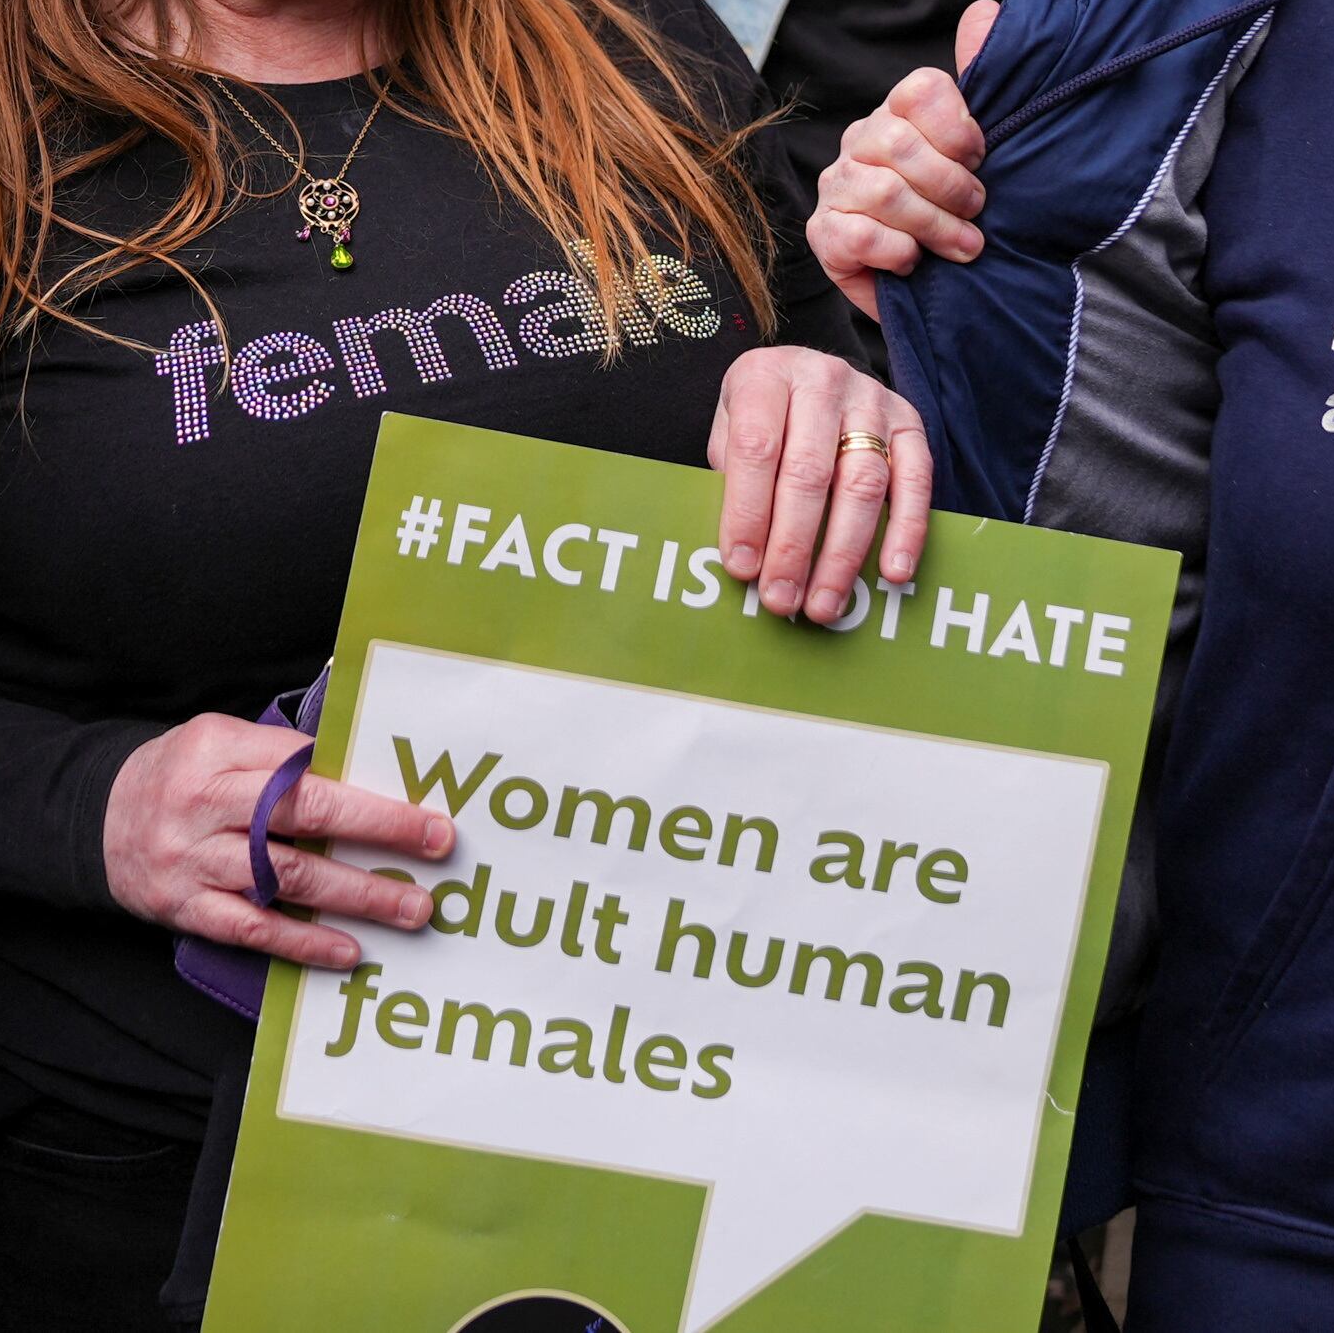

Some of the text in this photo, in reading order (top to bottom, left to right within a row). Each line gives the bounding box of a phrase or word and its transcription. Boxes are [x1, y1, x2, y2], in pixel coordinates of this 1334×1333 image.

[156, 238, 722, 445] female
[395, 494, 639, 594] #FACT
[653, 540, 722, 609] IS
[929, 585, 1132, 676] HATE
[392, 734, 970, 904] Women are
[325, 961, 737, 1099] females
[369, 862, 1013, 1029] dult human
